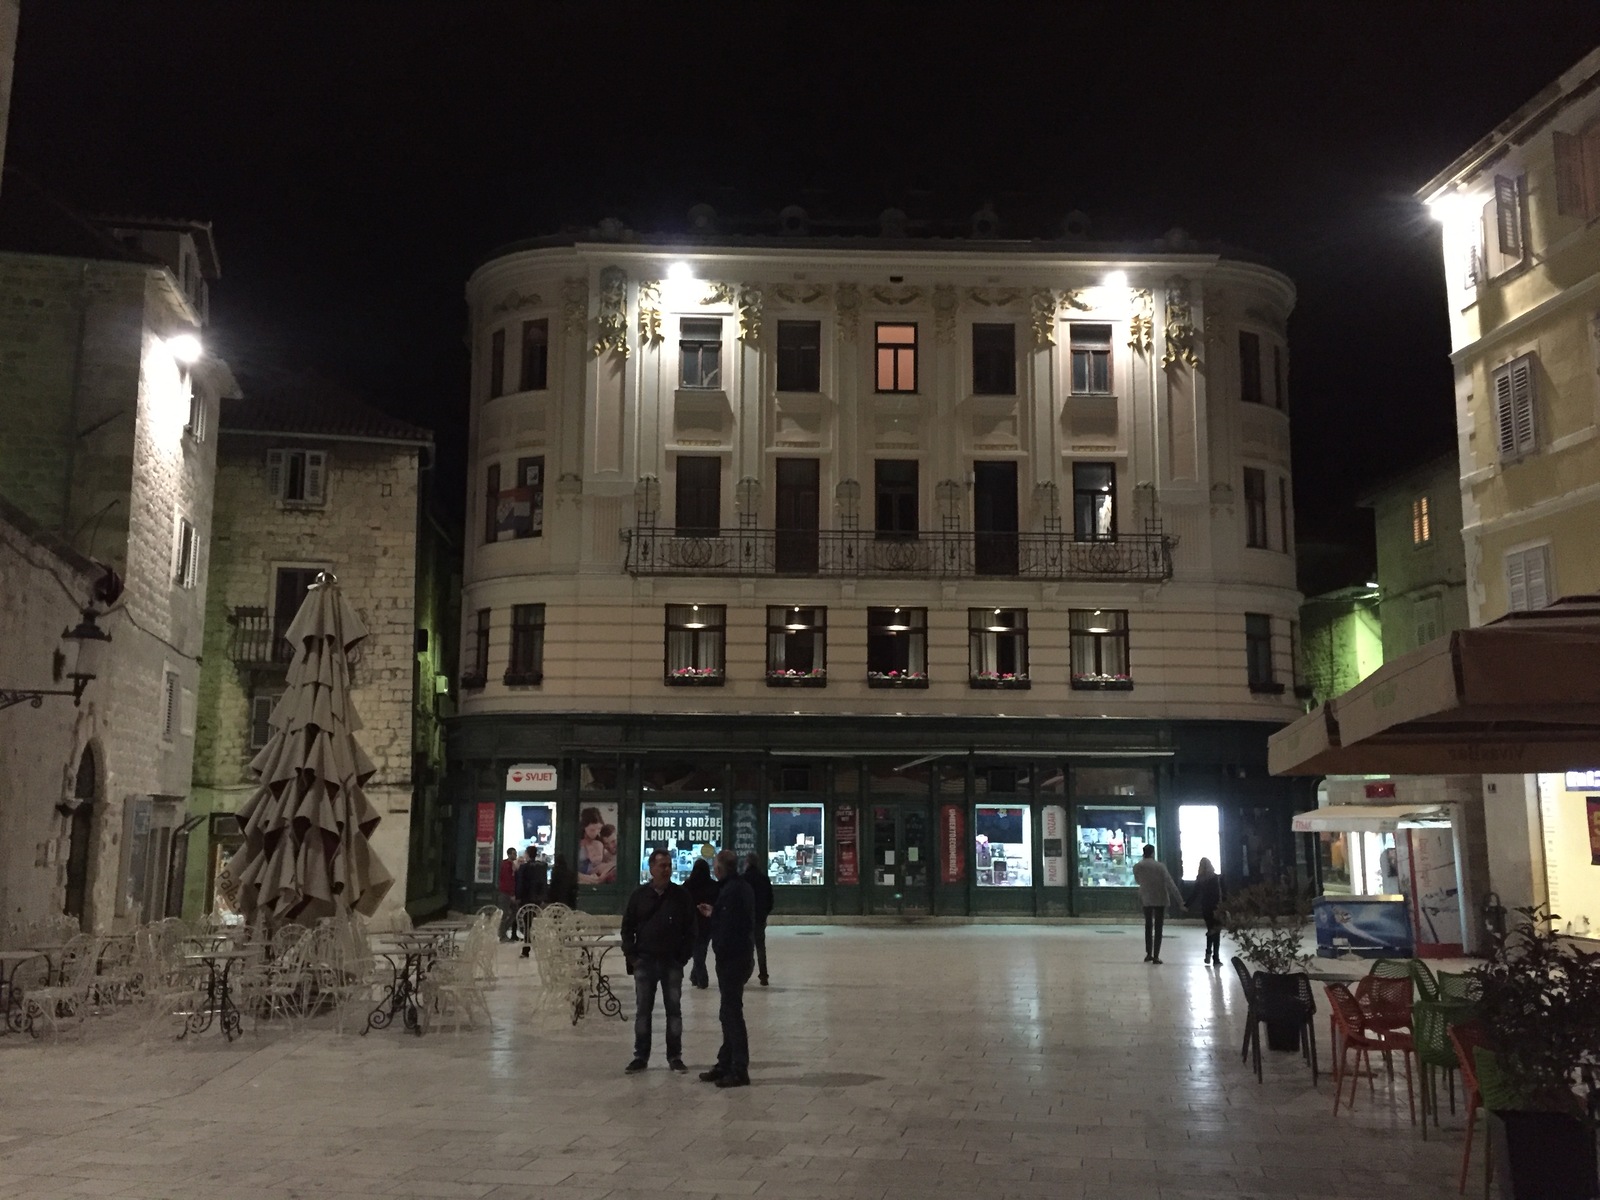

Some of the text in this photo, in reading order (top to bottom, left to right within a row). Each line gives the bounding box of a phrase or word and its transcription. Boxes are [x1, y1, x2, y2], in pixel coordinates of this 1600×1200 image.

[526, 772, 553, 781] SVIJET
[645, 815, 721, 827] SUDBE I SRDŽBE
[645, 830, 721, 841] LAUREN GROFF
